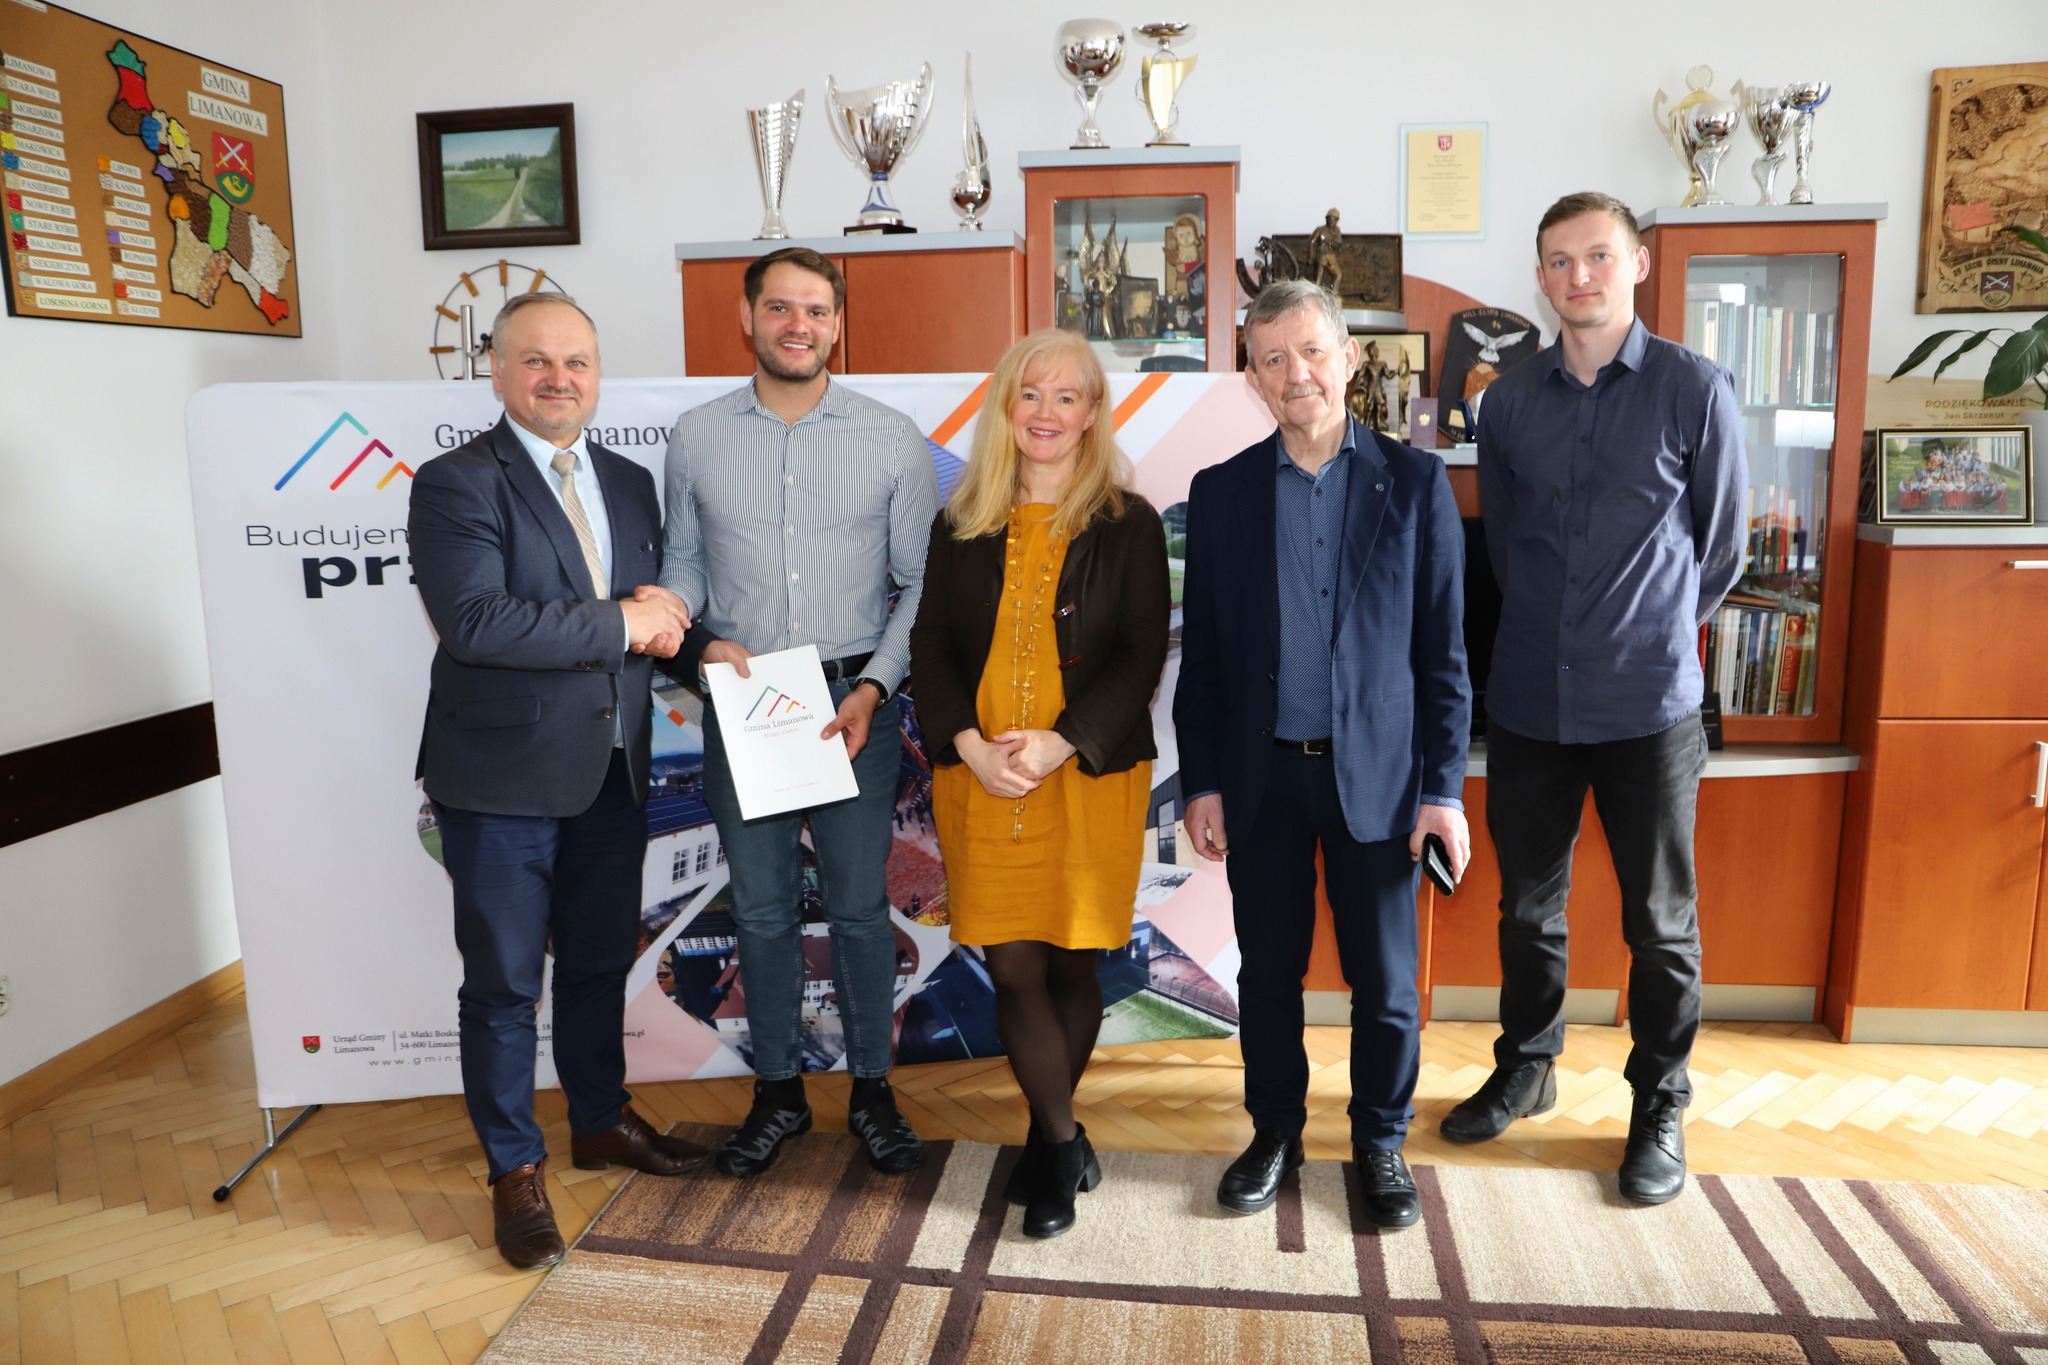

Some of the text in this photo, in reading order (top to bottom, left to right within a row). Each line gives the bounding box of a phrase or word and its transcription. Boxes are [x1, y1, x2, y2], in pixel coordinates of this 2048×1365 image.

[5, 57, 52, 78] LIMANOWA
[9, 79, 36, 94] STARA
[203, 72, 248, 99] GMINA
[15, 103, 58, 120] MORDARKA
[190, 96, 263, 131] LIMANOWA
[28, 217, 54, 230] STARE
[2011, 258, 2044, 274] LIMANOWA
[1925, 397, 2027, 410] PODZIĘKOWANIE
[1962, 411, 2005, 419] Skrzekut
[434, 422, 494, 448] Gm
[743, 713, 815, 733] Gmina Limanowa
[333, 1033, 386, 1044] Urząd Gminy
[411, 1030, 433, 1038] Matki
[334, 1046, 376, 1054] Limanowa
[400, 1041, 427, 1049] 34-600
